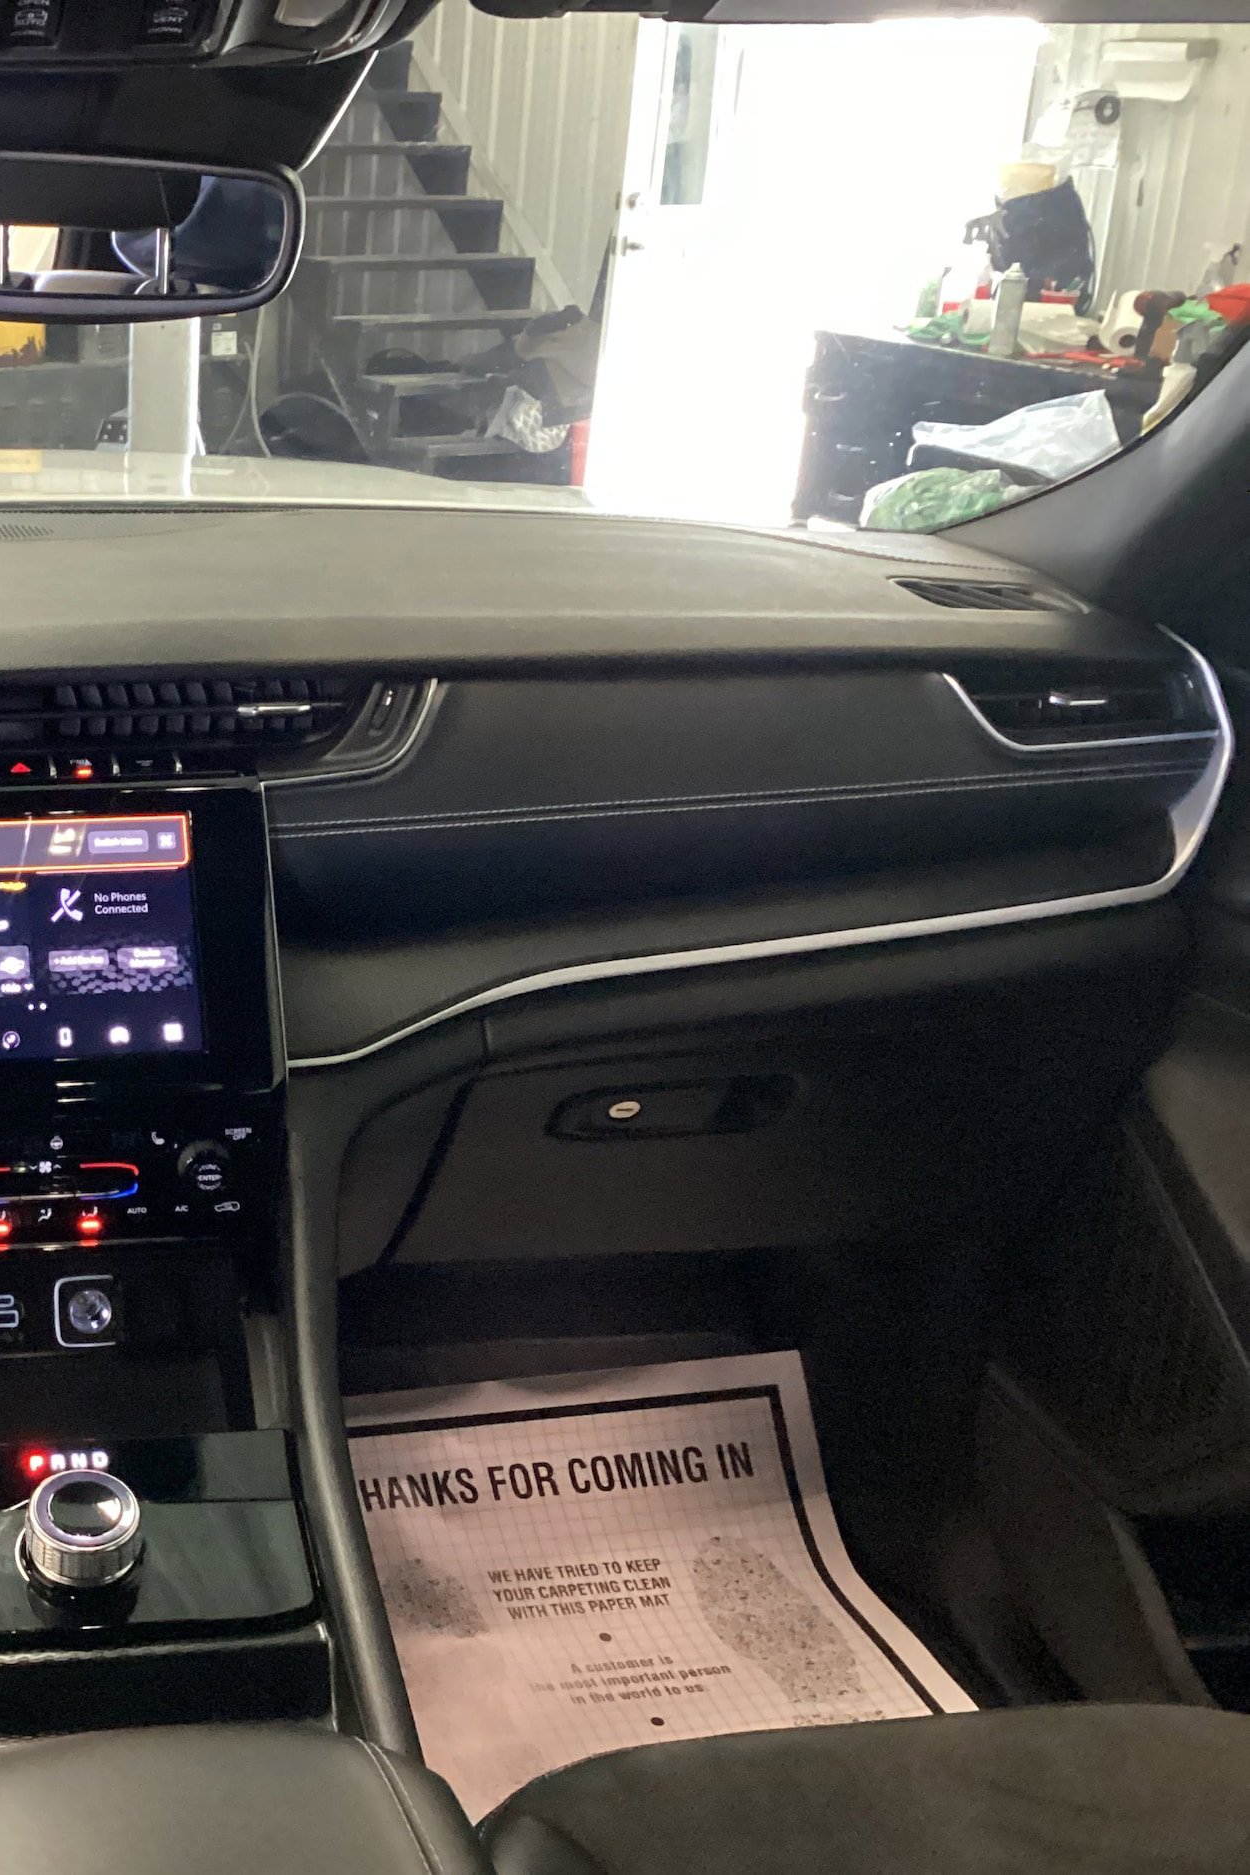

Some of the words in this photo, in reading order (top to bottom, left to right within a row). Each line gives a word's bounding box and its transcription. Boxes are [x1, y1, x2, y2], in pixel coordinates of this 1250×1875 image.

[94, 892, 109, 903] No
[110, 891, 147, 902] Phones
[94, 903, 149, 915] Connected
[127, 1206, 148, 1215] AUTO
[174, 1204, 189, 1213] A/C
[91, 1450, 109, 1468] D
[359, 1467, 479, 1512] HANKS
[487, 1461, 560, 1501] FOR
[568, 1446, 709, 1494] COMING
[715, 1441, 755, 1480] IN
[487, 1569, 513, 1584] WE
[514, 1566, 553, 1583] HAVE
[556, 1562, 600, 1579] TRIED
[603, 1561, 623, 1575] TO
[625, 1558, 662, 1573] KEEP
[493, 1587, 536, 1603] YOUR
[538, 1580, 621, 1600] CARPETING
[623, 1576, 672, 1592] CLEAN
[507, 1605, 549, 1621] WITH
[551, 1601, 586, 1617] THIS
[588, 1597, 637, 1613] PAPER
[641, 1593, 671, 1608] MAT
[570, 1662, 582, 1675] A
[585, 1657, 655, 1673] customer
[657, 1654, 674, 1666] is
[529, 1681, 556, 1694] the
[559, 1677, 598, 1691] most
[601, 1669, 676, 1687] important
[678, 1663, 732, 1681] person
[569, 1693, 587, 1705] in
[589, 1690, 616, 1703] the
[618, 1685, 663, 1701] world
[664, 1684, 682, 1696] to
[684, 1683, 705, 1694] us
